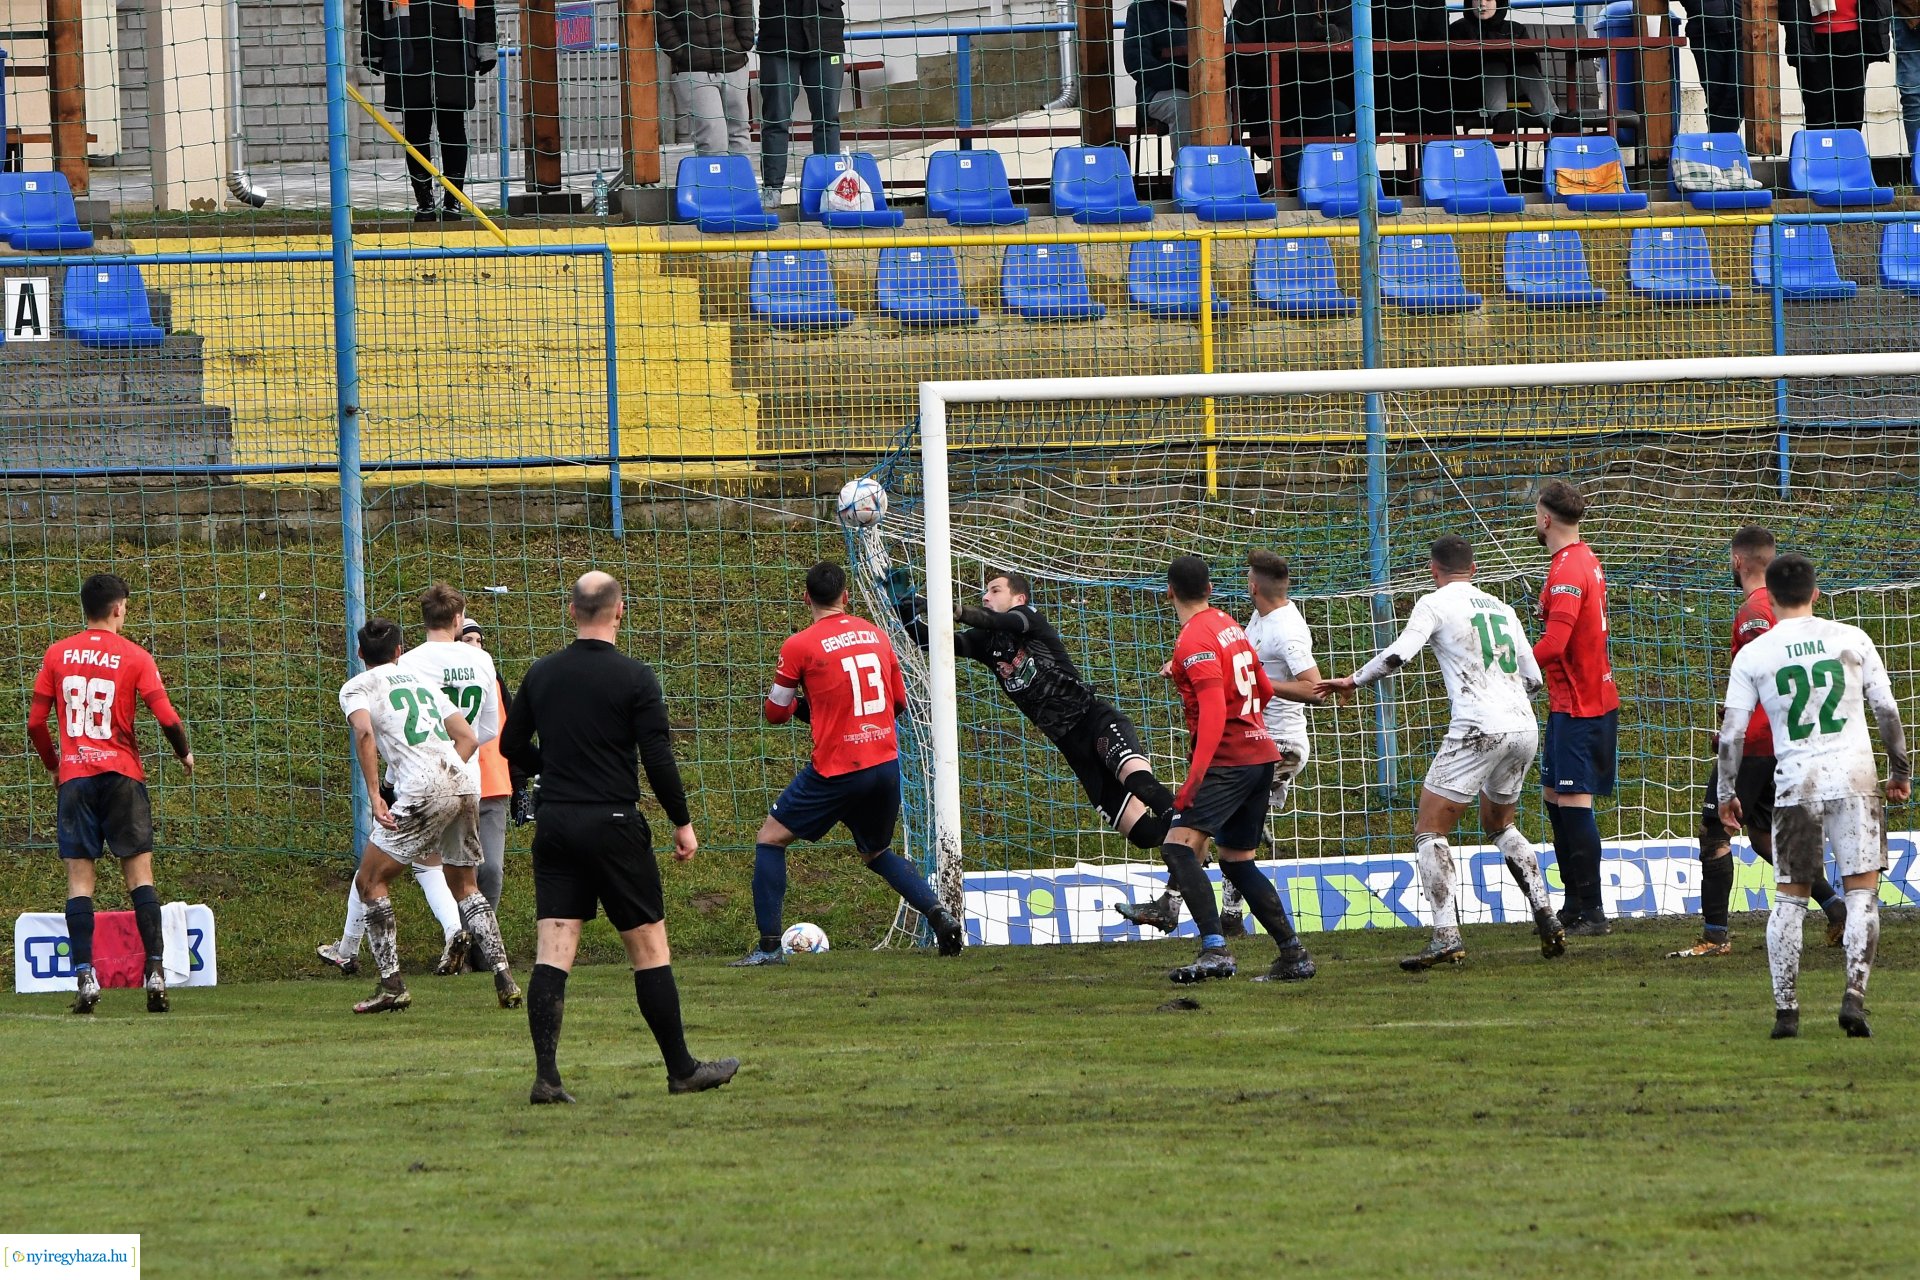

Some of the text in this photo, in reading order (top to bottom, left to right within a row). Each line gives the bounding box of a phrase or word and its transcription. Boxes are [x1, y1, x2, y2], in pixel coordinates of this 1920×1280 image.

[14, 283, 41, 336] A
[63, 649, 121, 669] FARKAS
[1470, 612, 1518, 674] 15
[1785, 639, 1826, 659] TOMA
[443, 667, 476, 683] BACSA
[841, 652, 886, 717] 13
[1775, 659, 1848, 741] 22
[62, 675, 116, 740] 88
[388, 687, 453, 746] 23
